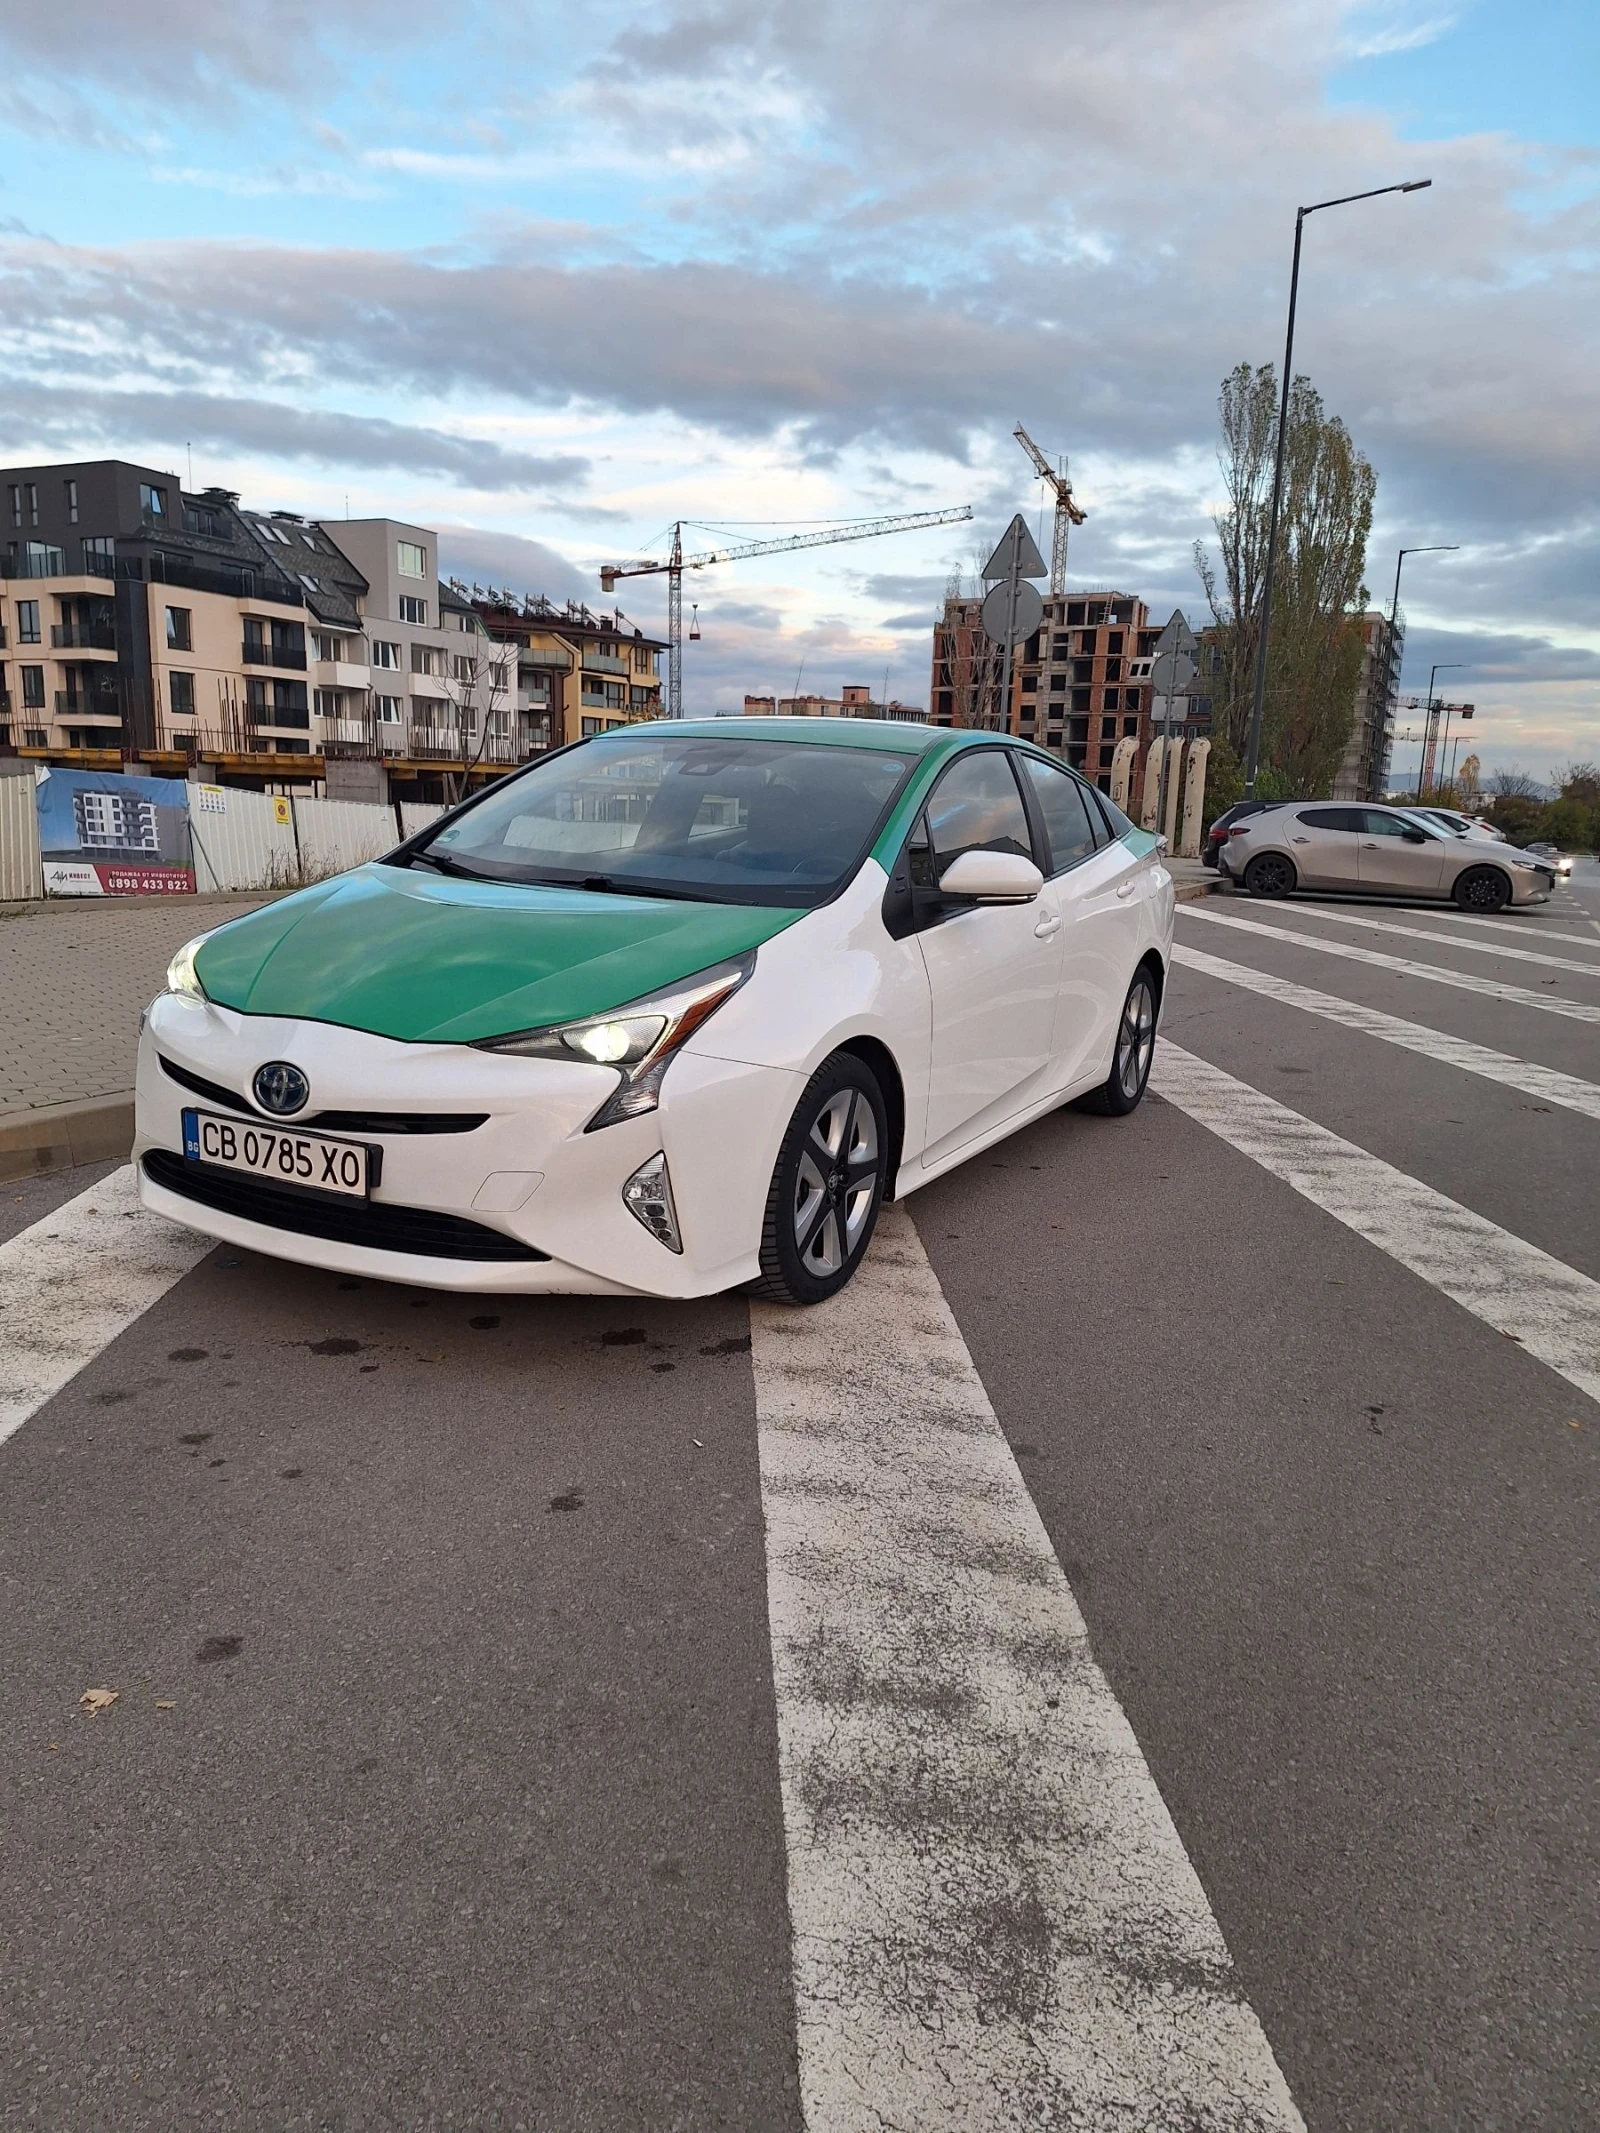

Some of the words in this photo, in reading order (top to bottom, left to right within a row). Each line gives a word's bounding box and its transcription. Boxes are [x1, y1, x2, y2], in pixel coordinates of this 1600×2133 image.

[108, 878, 139, 889] 0898
[142, 879, 164, 890] 433
[167, 880, 189, 890] 822
[187, 1140, 199, 1153] BG
[203, 1121, 238, 1161] CB
[244, 1130, 313, 1178] 0785
